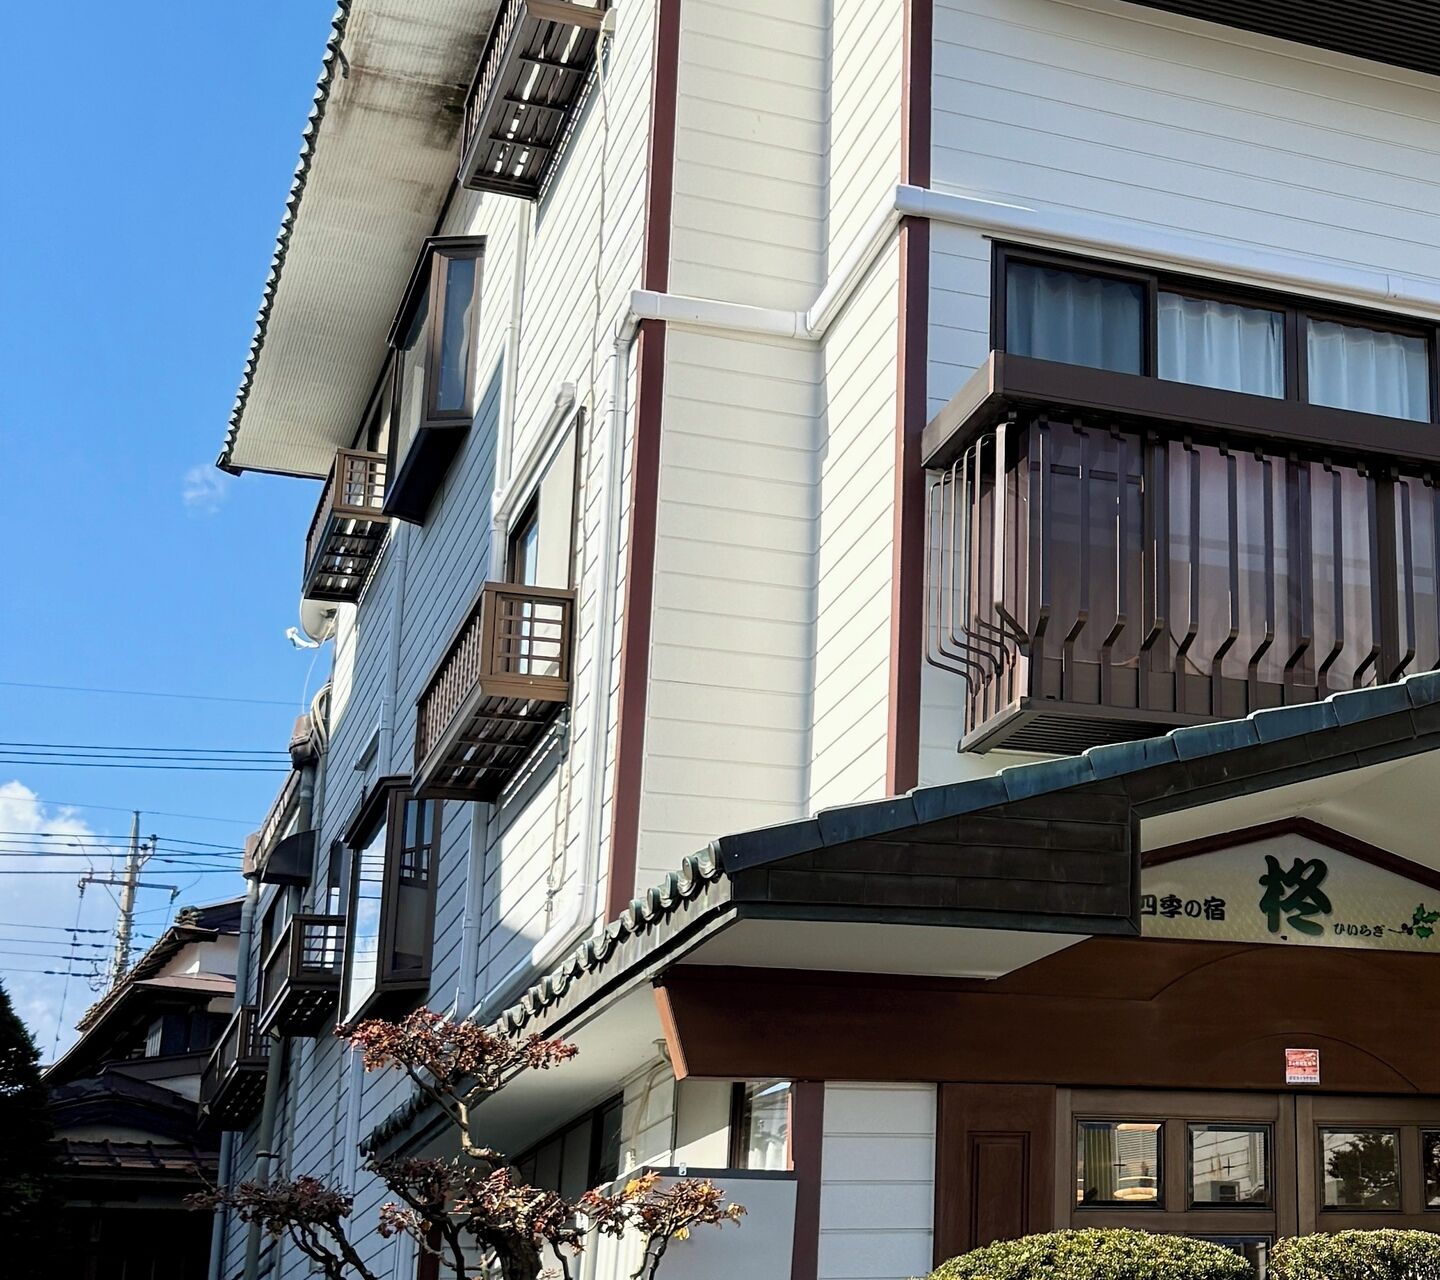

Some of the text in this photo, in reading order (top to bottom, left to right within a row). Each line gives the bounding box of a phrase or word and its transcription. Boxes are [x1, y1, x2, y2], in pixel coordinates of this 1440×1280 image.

[1141, 854, 1333, 937] 四季の宿 柊
[1333, 922, 1385, 938] ひいらぎ
